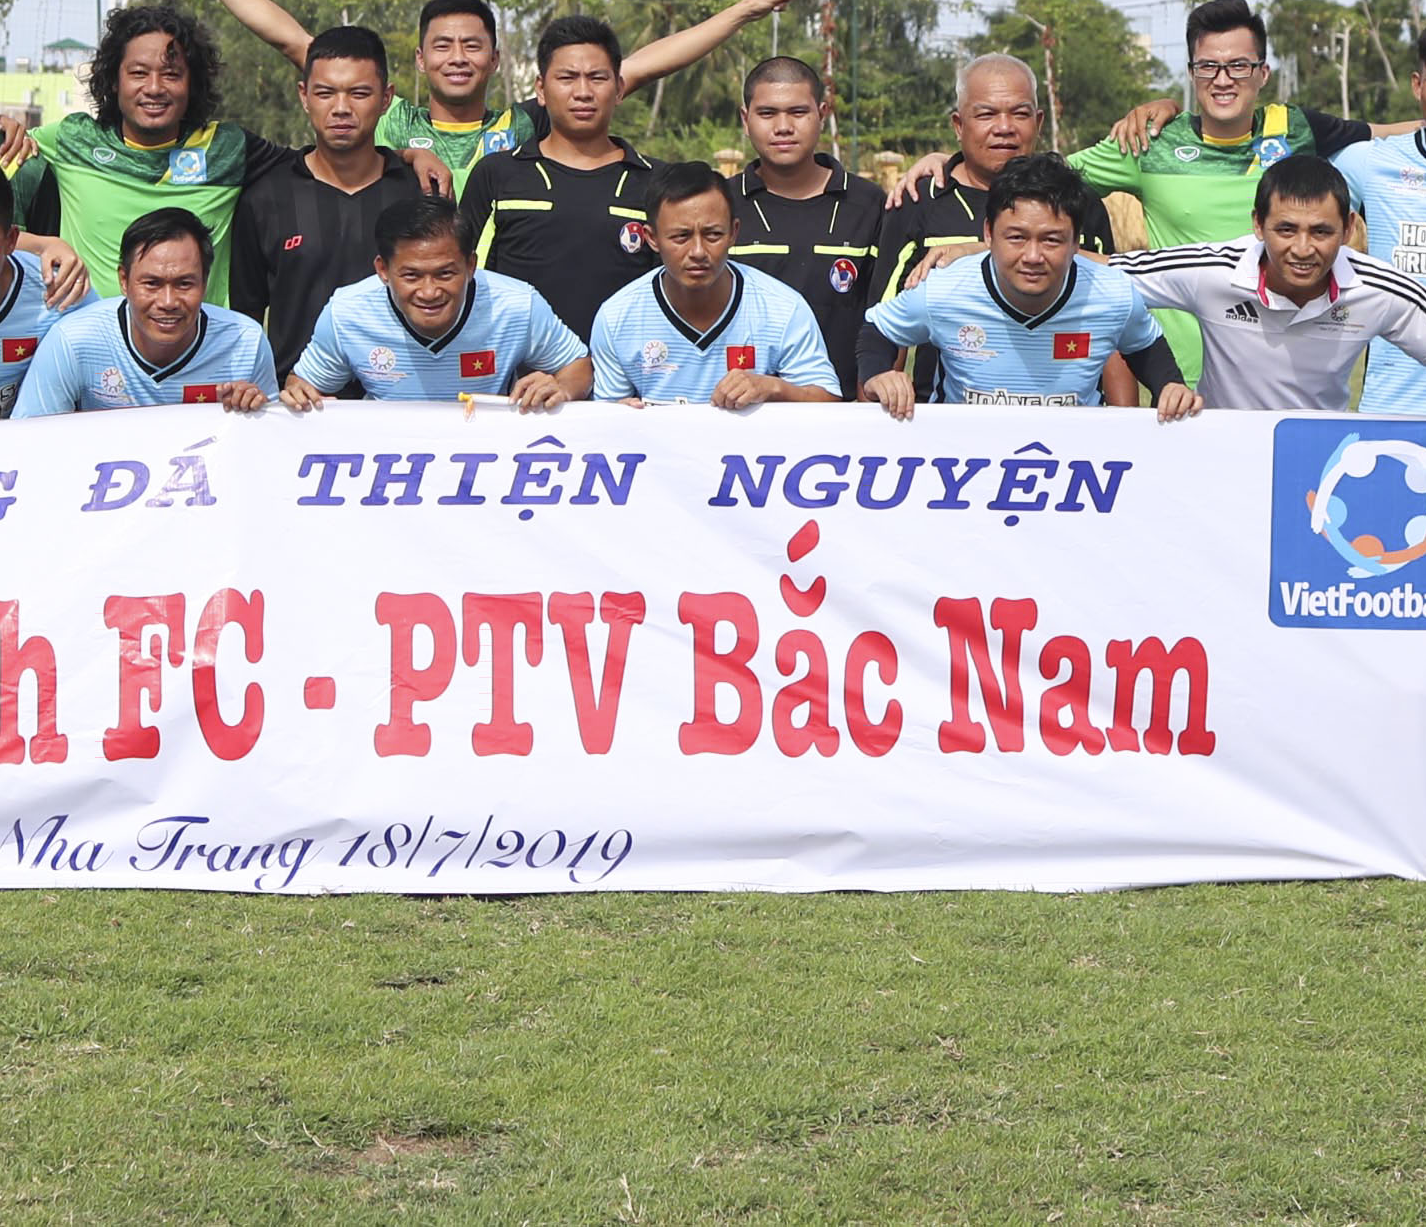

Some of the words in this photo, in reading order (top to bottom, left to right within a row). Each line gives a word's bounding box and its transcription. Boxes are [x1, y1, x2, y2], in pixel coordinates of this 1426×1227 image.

[1225, 314, 1258, 323] adidas
[0, 383, 17, 401] S
[81, 434, 219, 512] ĐÁ
[296, 434, 647, 522] THIỆN
[707, 441, 1133, 527] NGUYỆN
[102, 587, 265, 762] FC
[374, 591, 647, 757] PTV
[678, 519, 904, 758] Bắc
[933, 597, 1217, 757] Nam
[129, 815, 325, 891] Trang
[337, 814, 634, 884] 18/7/2019
